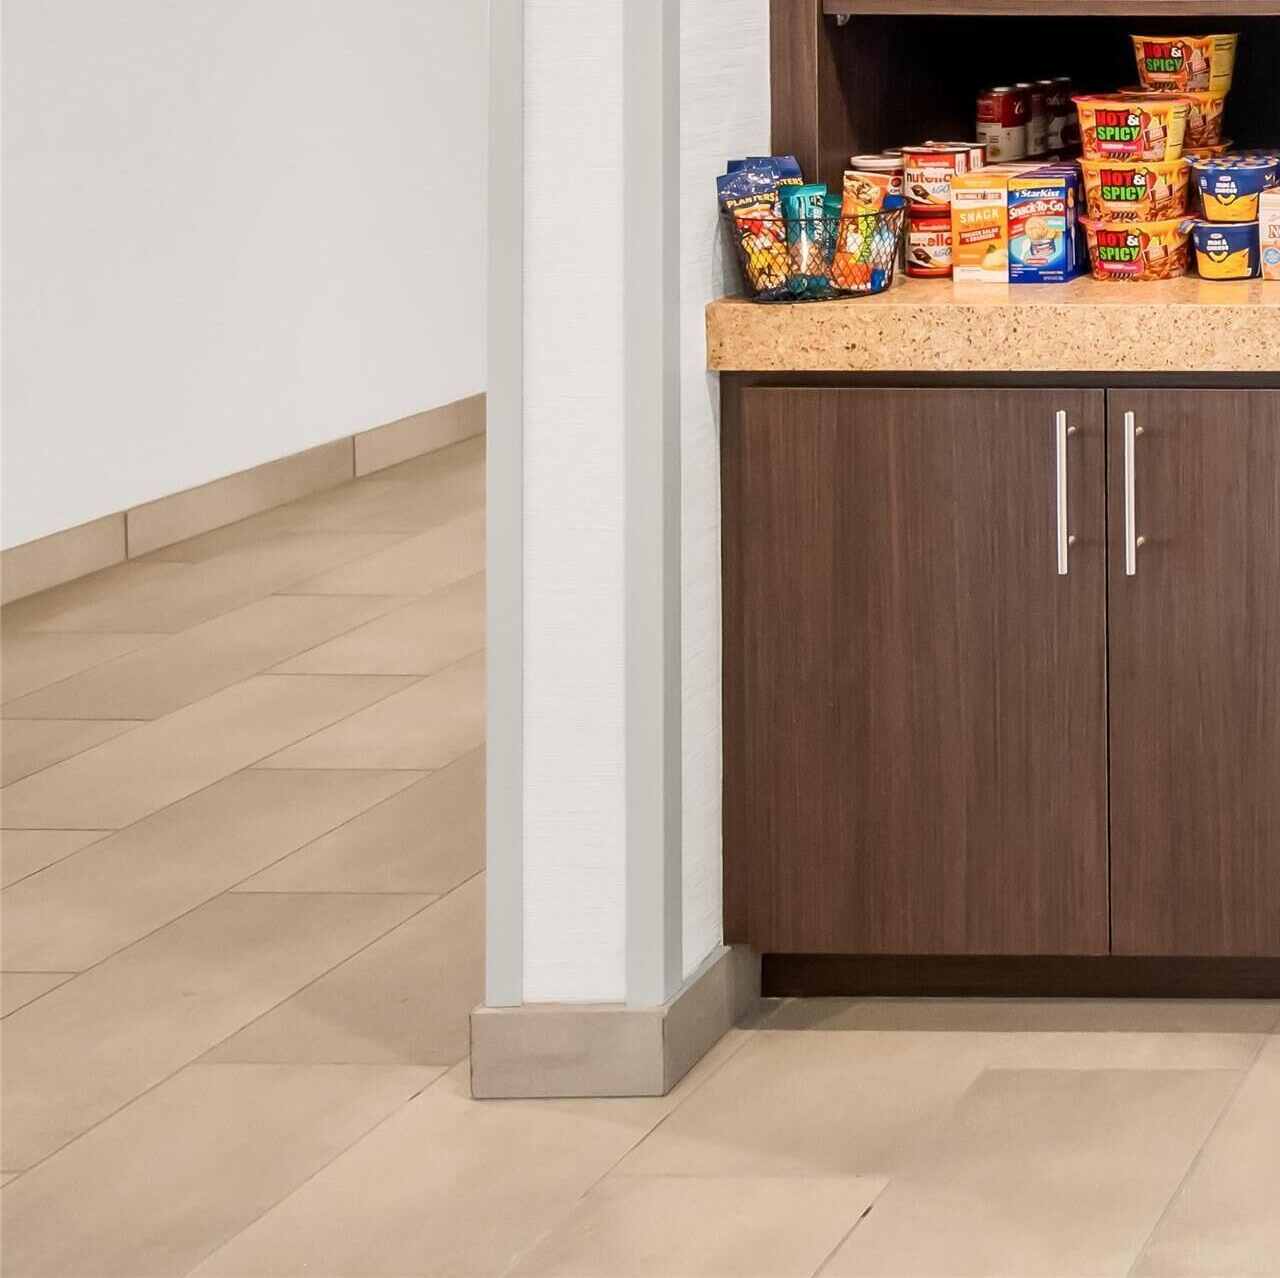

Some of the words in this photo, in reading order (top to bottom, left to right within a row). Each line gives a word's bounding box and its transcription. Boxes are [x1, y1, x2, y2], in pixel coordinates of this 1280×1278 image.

[1171, 47, 1182, 58] &
[1146, 59, 1182, 72] SPICY
[1095, 111, 1128, 126] HOT
[1128, 114, 1140, 126] &
[1097, 127, 1140, 141] SPICY
[1101, 170, 1133, 186] HOT
[1133, 174, 1146, 186] &
[726, 192, 776, 209] PLANTERS
[1021, 188, 1060, 198] StarKist
[1103, 186, 1146, 201] SPICY
[960, 209, 1000, 224] SNACK
[1097, 232, 1128, 247] HOT
[1126, 235, 1139, 247] &
[1100, 247, 1139, 261] SPICY
